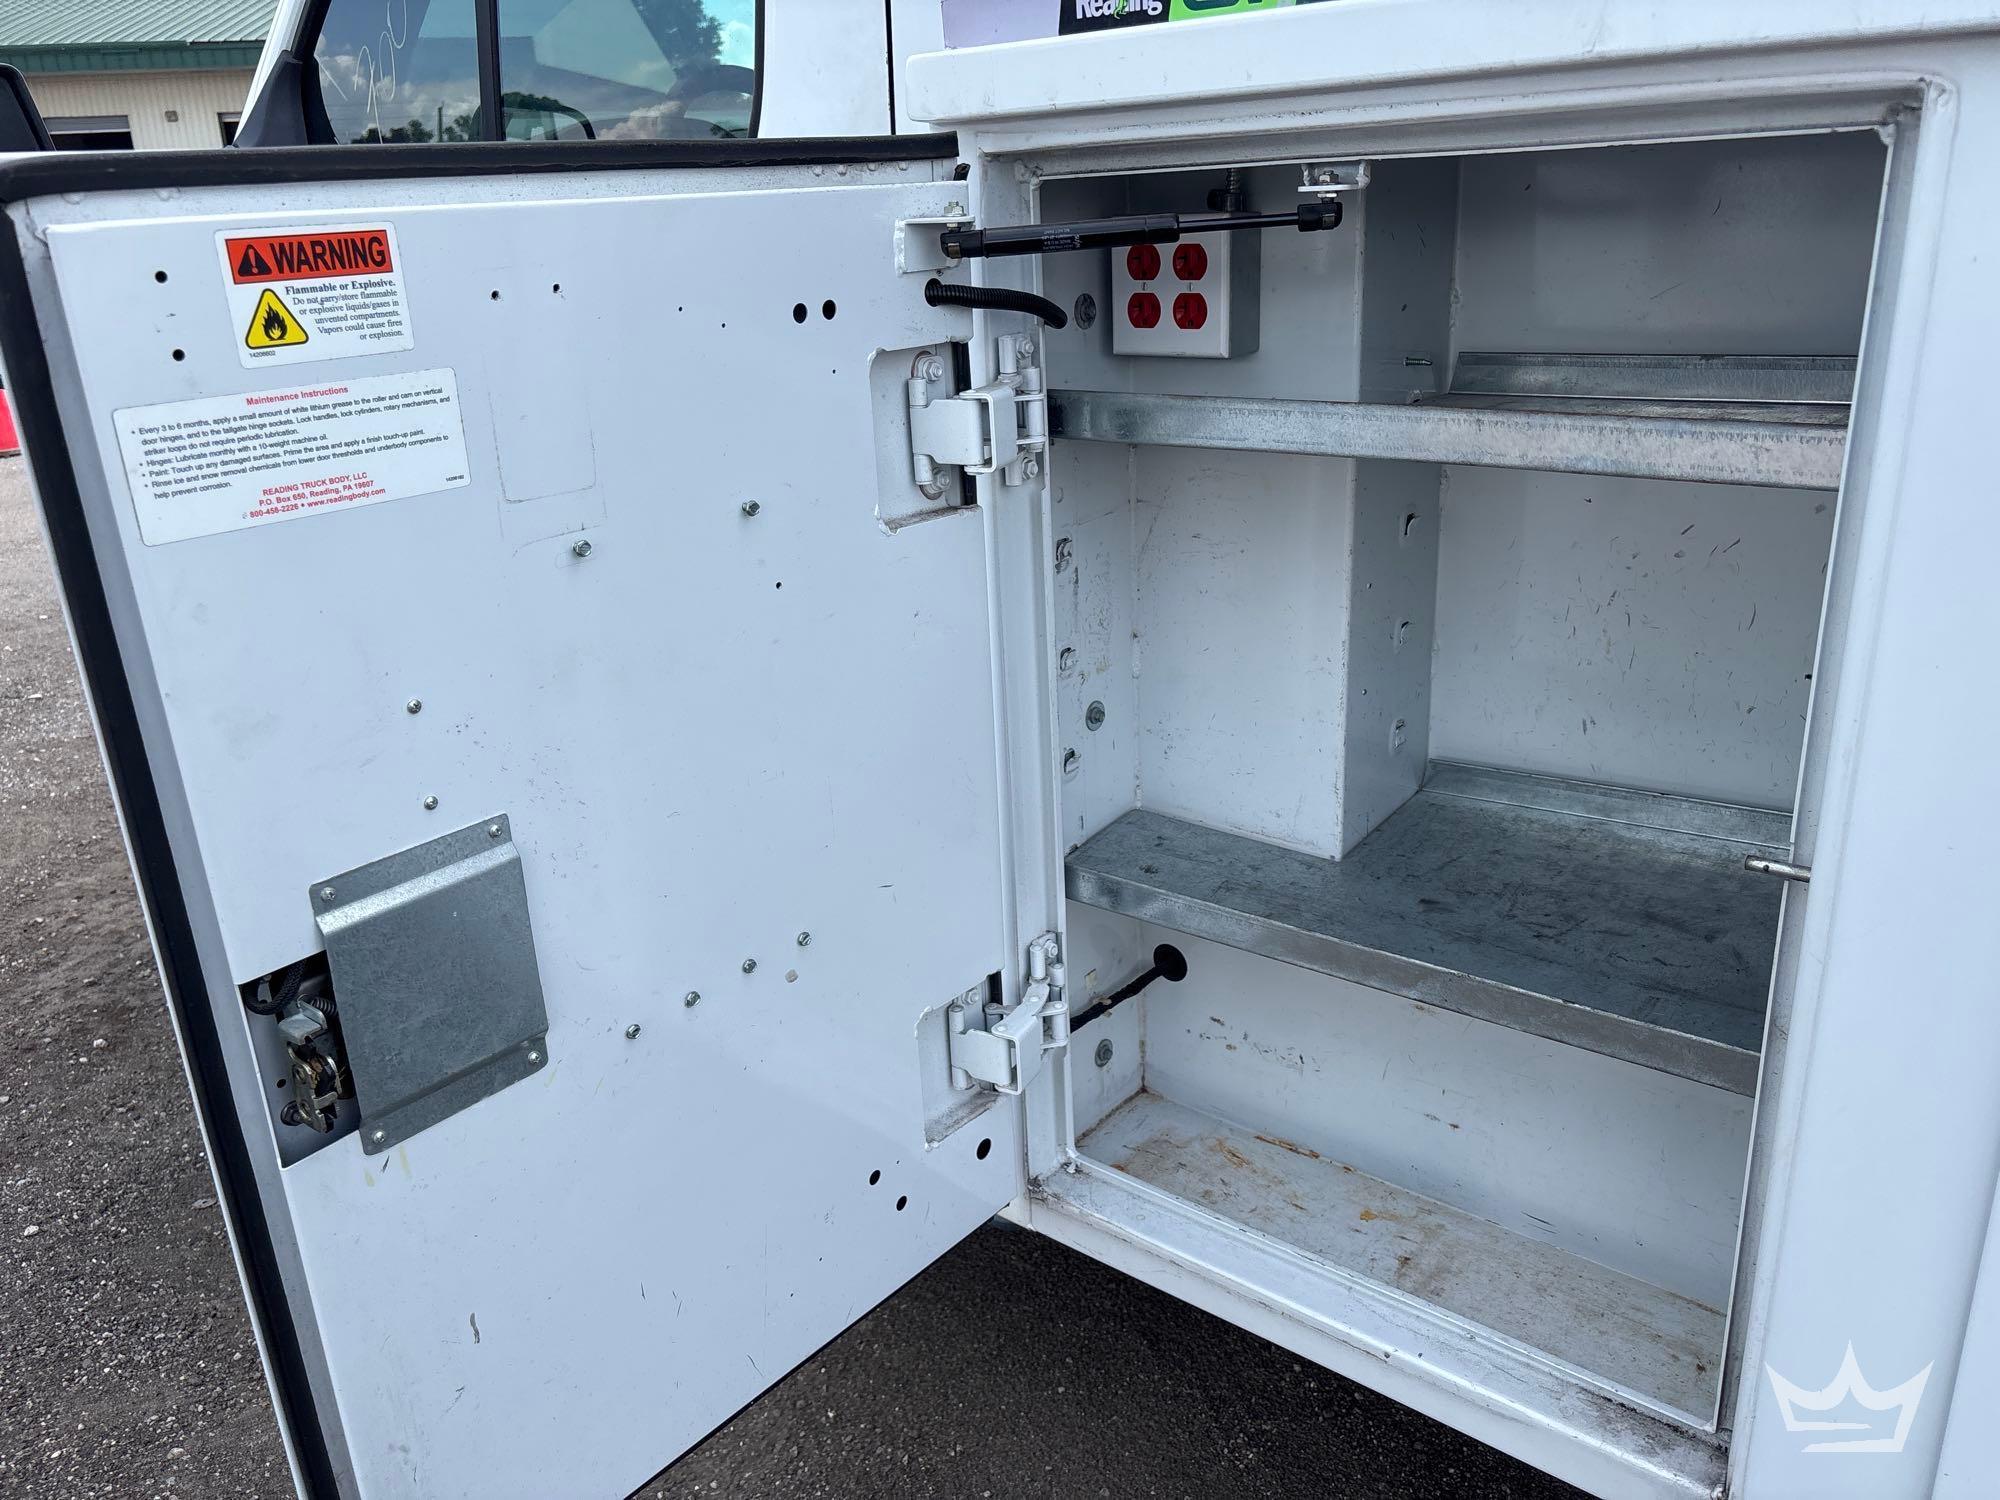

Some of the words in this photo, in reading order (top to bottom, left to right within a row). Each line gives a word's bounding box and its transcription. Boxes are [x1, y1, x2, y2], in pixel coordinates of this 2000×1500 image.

[270, 236, 386, 274] WARNING
[284, 282, 338, 296] Flammable
[339, 281, 349, 291] or
[351, 278, 396, 290] Explosive.
[292, 297, 305, 306] Do
[306, 296, 320, 305] not
[321, 293, 359, 305] carry/store
[360, 289, 398, 299] flammable
[299, 308, 307, 317] or
[309, 304, 345, 315] explosive
[346, 301, 391, 312] liquids/gases
[392, 299, 400, 307] in
[314, 314, 349, 326] unvented
[350, 310, 401, 321] compartments.
[317, 325, 344, 335] Vapors
[345, 322, 365, 333] could
[366, 321, 387, 331] cause
[387, 320, 403, 328] fires
[360, 332, 367, 340] or
[369, 329, 404, 340] explosion.
[246, 393, 299, 406] Maintenance
[301, 386, 349, 399] Instructions
[139, 426, 160, 435] Every
[176, 422, 183, 430] 6
[183, 420, 212, 429] months,
[212, 416, 231, 426] apply
[239, 412, 257, 422] small
[258, 409, 284, 419] amount
[291, 406, 309, 415] white
[310, 404, 331, 412] lithium
[331, 401, 353, 410] grease
[361, 397, 372, 405] the
[372, 394, 388, 404] roller
[389, 393, 400, 401] and
[423, 387, 443, 396] vertical
[141, 438, 158, 447] door
[159, 434, 186, 444] hinges,
[187, 431, 201, 440] and
[201, 430, 210, 438] to
[210, 429, 222, 437] the
[222, 425, 248, 434] tailgate
[248, 423, 268, 431] hinge
[268, 419, 296, 428] sockets.
[296, 415, 313, 424] Lock
[313, 412, 340, 422] handles,
[340, 410, 354, 418] lock
[354, 407, 383, 416] cylinders,
[383, 403, 401, 412] rotary
[402, 397, 439, 409] mechanisms,
[440, 395, 451, 403] and
[144, 448, 167, 458] striker
[167, 444, 188, 454] loops
[188, 443, 198, 451] do
[199, 440, 211, 448] not
[212, 438, 236, 446] require
[237, 433, 264, 444] periodic
[264, 428, 300, 439] lubrication.
[146, 457, 174, 467] Hinges:
[175, 452, 208, 463] Lubricate
[209, 448, 236, 458] monthly
[237, 445, 252, 453] with
[259, 439, 291, 451] 10-weight
[291, 436, 319, 446] machine
[149, 469, 171, 479] Paint:
[171, 465, 195, 474] Touch
[220, 455, 252, 467] damaged
[252, 452, 281, 462] surfaces.
[303, 446, 315, 454] the
[315, 443, 330, 452] area
[331, 441, 343, 450] and
[344, 438, 360, 447] apply
[366, 434, 383, 444] finish
[383, 432, 409, 441] touch-up
[410, 429, 425, 437] paint.
[152, 480, 173, 490] Rinse
[173, 478, 185, 486] ice
[186, 474, 200, 484] and
[201, 472, 220, 482] snow
[220, 466, 248, 477] removal
[248, 462, 282, 473] chemicals
[298, 457, 316, 465] lower
[317, 454, 331, 462] door
[332, 448, 364, 460] thresholds
[365, 446, 376, 454] and
[377, 440, 408, 452] underbody
[408, 434, 442, 447] components
[443, 433, 449, 441] to
[154, 490, 171, 500] help
[171, 486, 198, 498] prevent
[199, 481, 233, 493] corrosion.
[259, 498, 275, 508] P.O.
[276, 496, 292, 504] Box
[309, 488, 342, 498] Reading,
[343, 483, 353, 492] PA
[354, 480, 374, 490] 19607
[263, 484, 299, 496] READING
[300, 478, 328, 490] TRUCK
[329, 474, 353, 485] BODY,
[353, 472, 368, 481] LLC
[250, 503, 299, 520] 800-458-2226
[307, 488, 386, 508] www.readingbody.com
